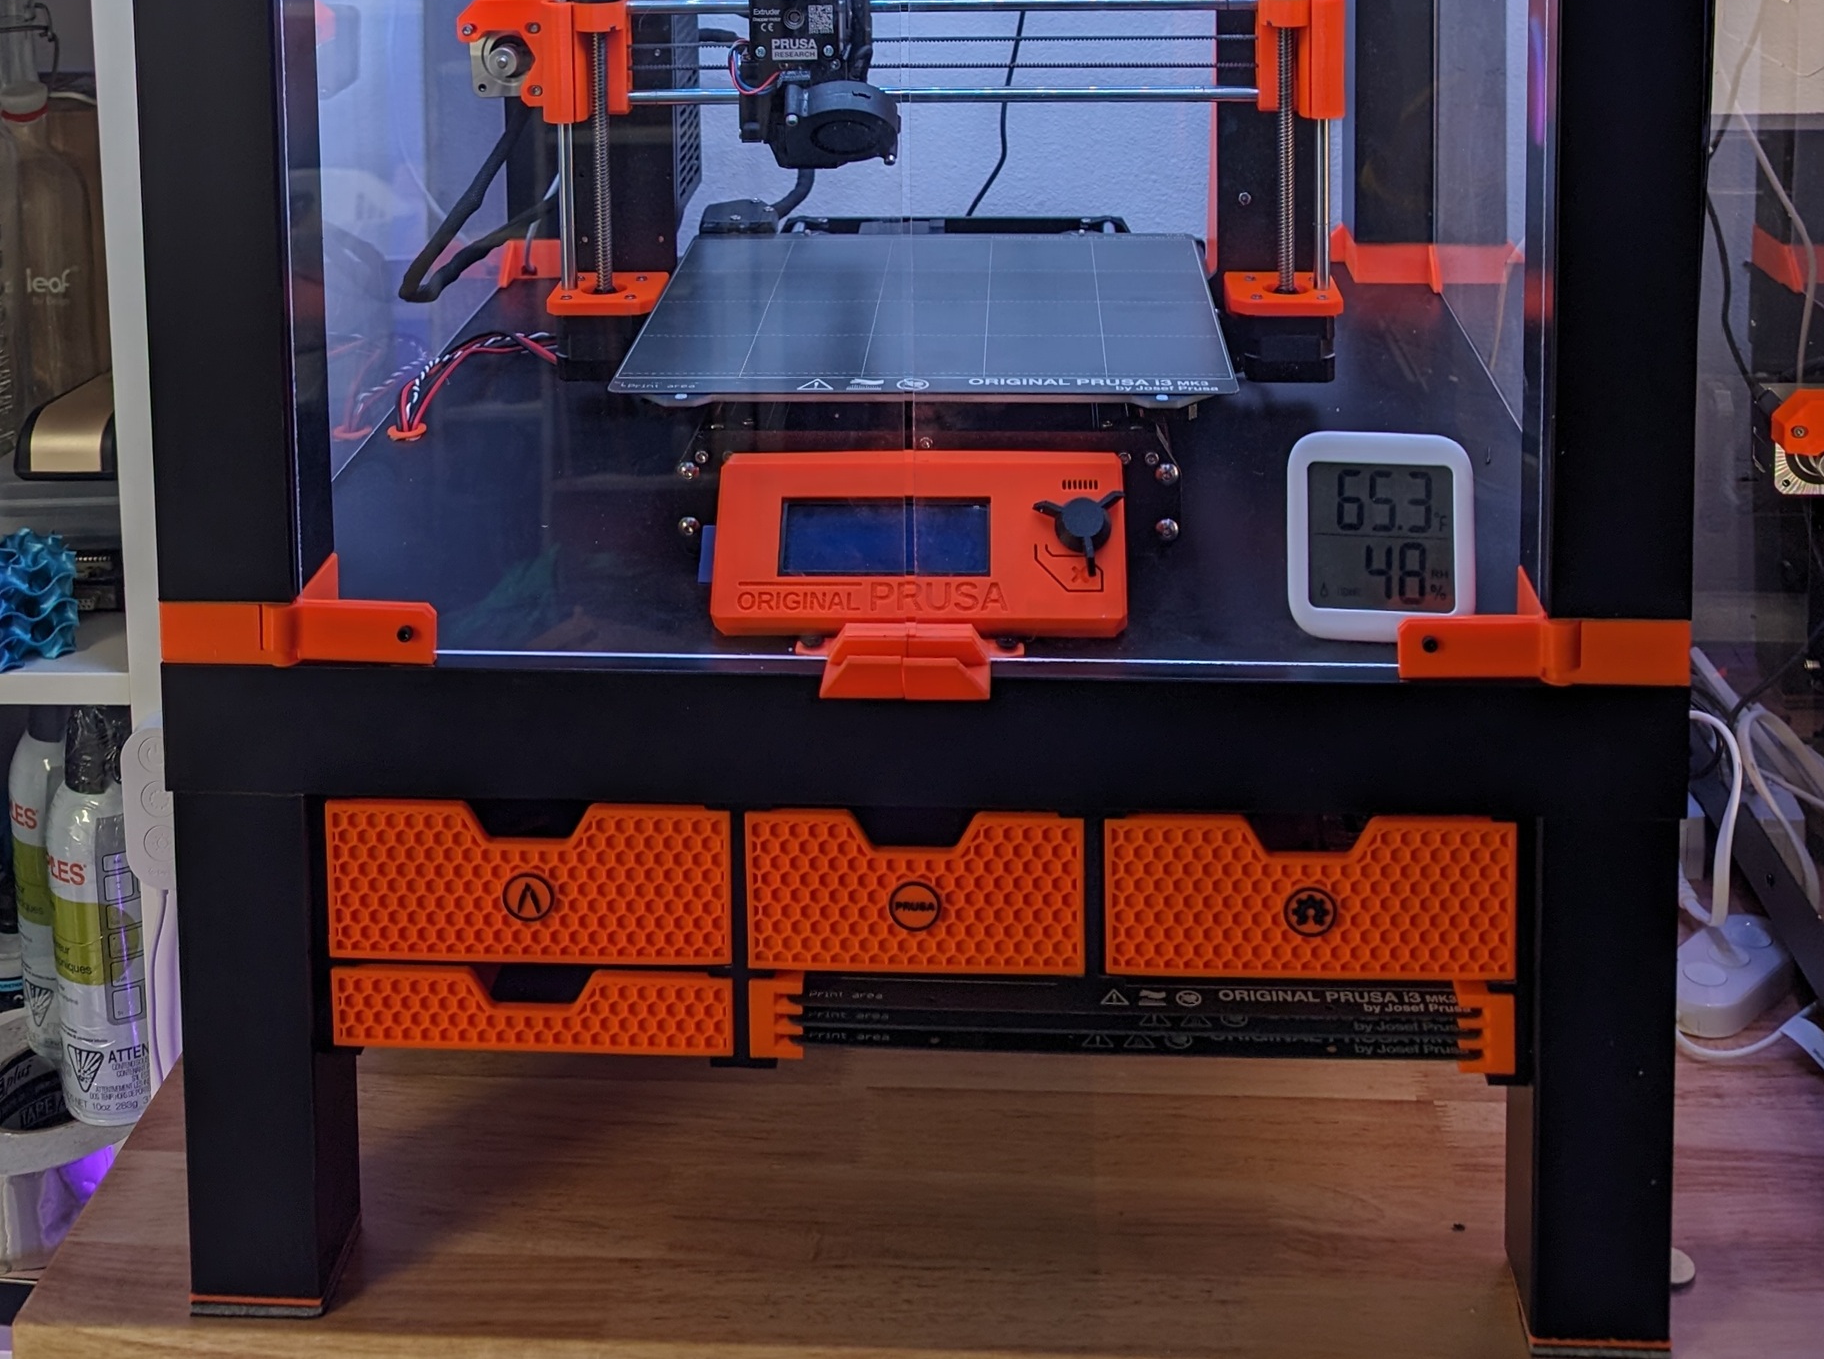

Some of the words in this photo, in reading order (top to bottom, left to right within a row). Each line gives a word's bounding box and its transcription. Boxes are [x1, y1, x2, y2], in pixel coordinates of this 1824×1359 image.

[753, 8, 780, 16] Extruder
[771, 39, 817, 49] PRUSA
[774, 50, 816, 58] RESEARCH
[26, 268, 70, 294] leaf
[968, 378, 1071, 386] ORIGINAL
[1077, 378, 1149, 387] PRUSA
[1336, 468, 1433, 533] 65.3
[1365, 542, 1427, 605] 48
[736, 590, 862, 612] ORIGINAL
[869, 580, 1010, 613] PRUSA
[894, 901, 936, 912] PRUSA
[808, 990, 844, 999] Print
[851, 992, 883, 1000] area
[1218, 989, 1320, 1003] ORIGINAL
[1325, 990, 1397, 1004] PRUSA
[1363, 1003, 1381, 1014] by
[1384, 1003, 1425, 1013] Josef
[855, 1012, 890, 1021] area
[1353, 1021, 1373, 1033] by
[1376, 1021, 1419, 1032] Josef
[856, 1032, 890, 1041] area
[1354, 1044, 1374, 1055] by
[1377, 1044, 1420, 1054] Josef
